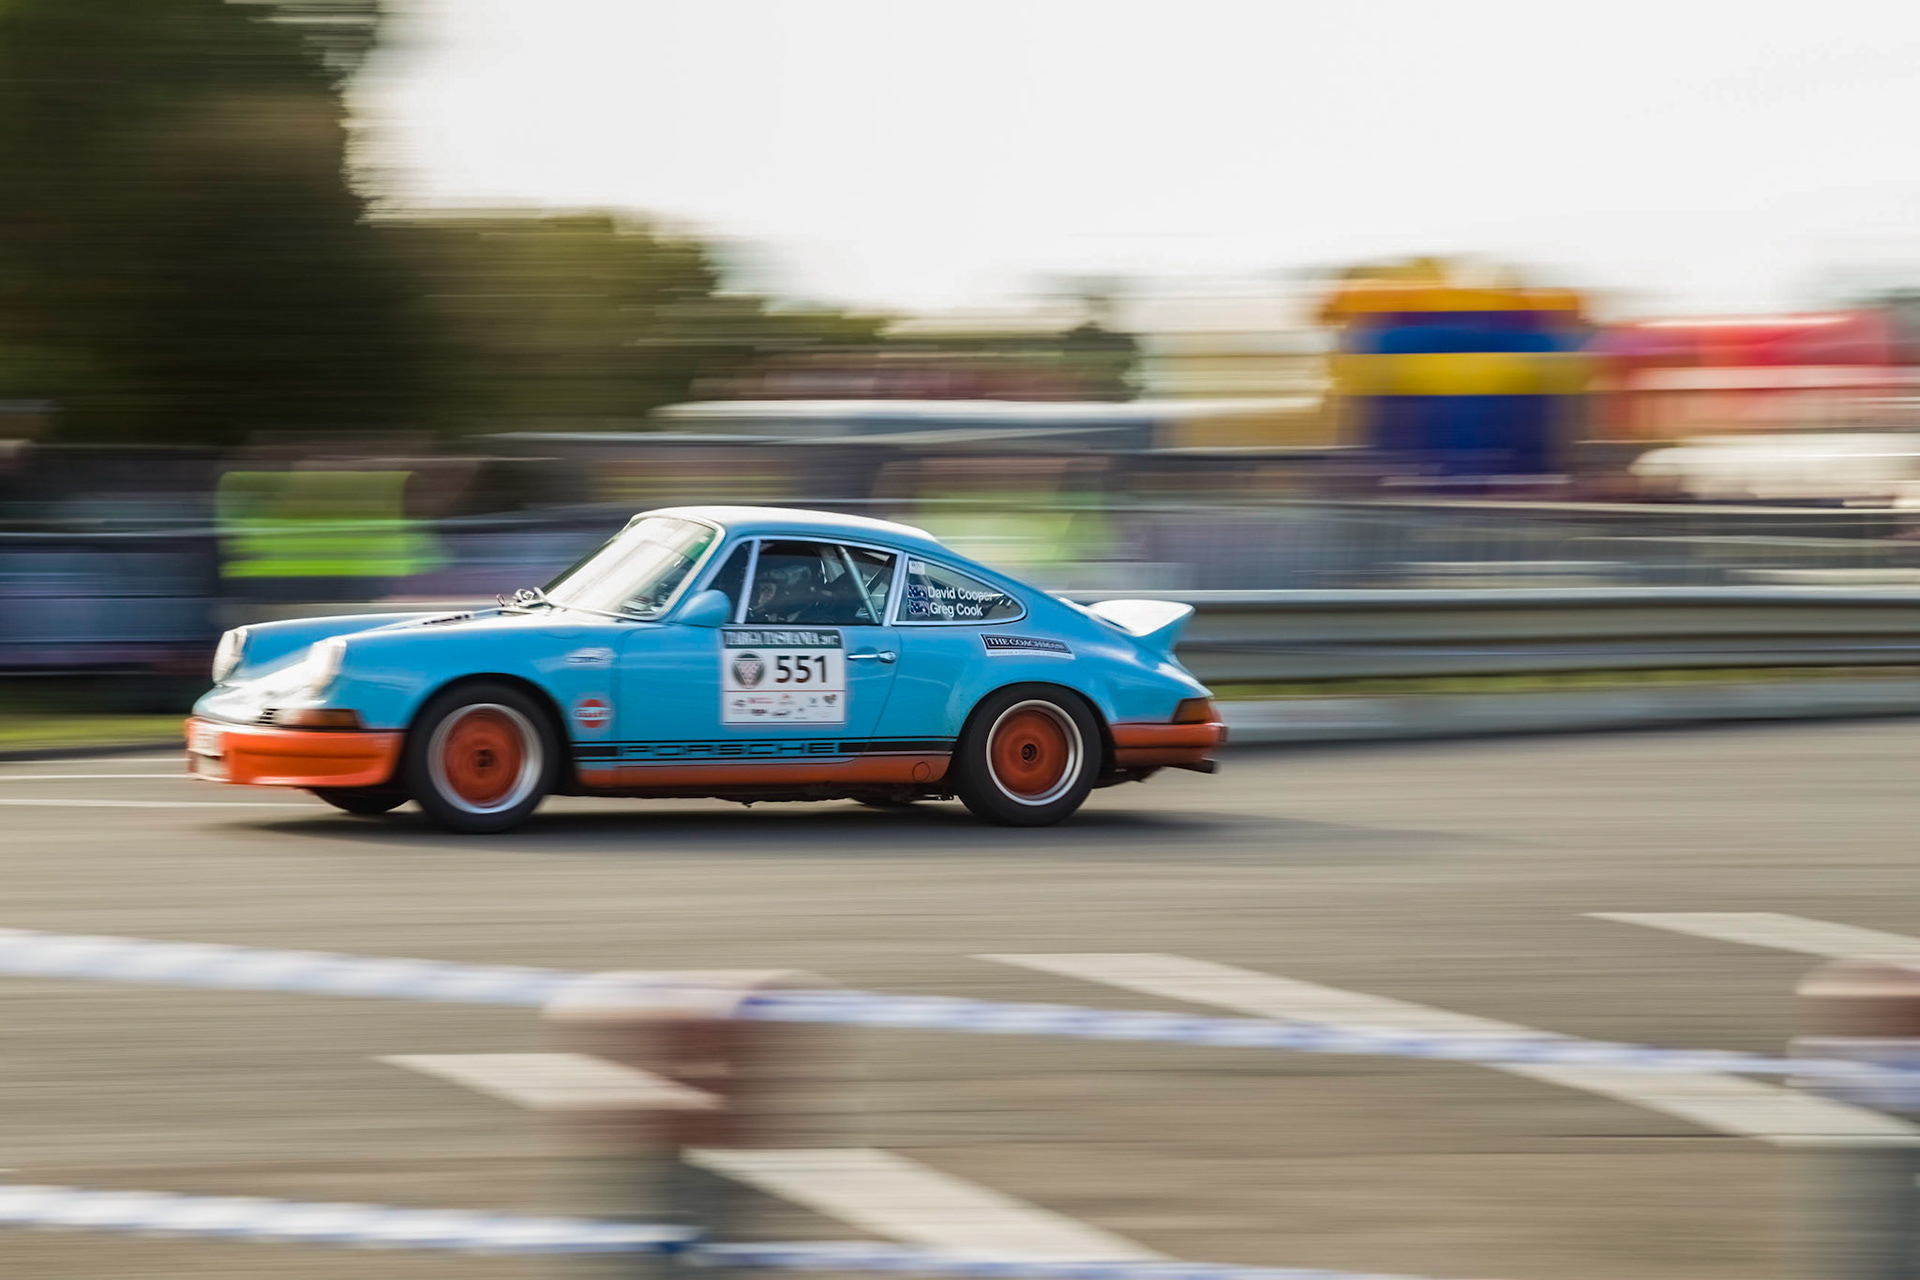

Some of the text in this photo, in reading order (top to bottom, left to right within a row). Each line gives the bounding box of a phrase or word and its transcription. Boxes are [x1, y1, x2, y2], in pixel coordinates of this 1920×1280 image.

[927, 586, 993, 603] David Cooper
[929, 602, 983, 618] Greg Cook
[987, 637, 1009, 646] THE
[775, 655, 827, 683] 551
[619, 742, 838, 757] PORSCHE
